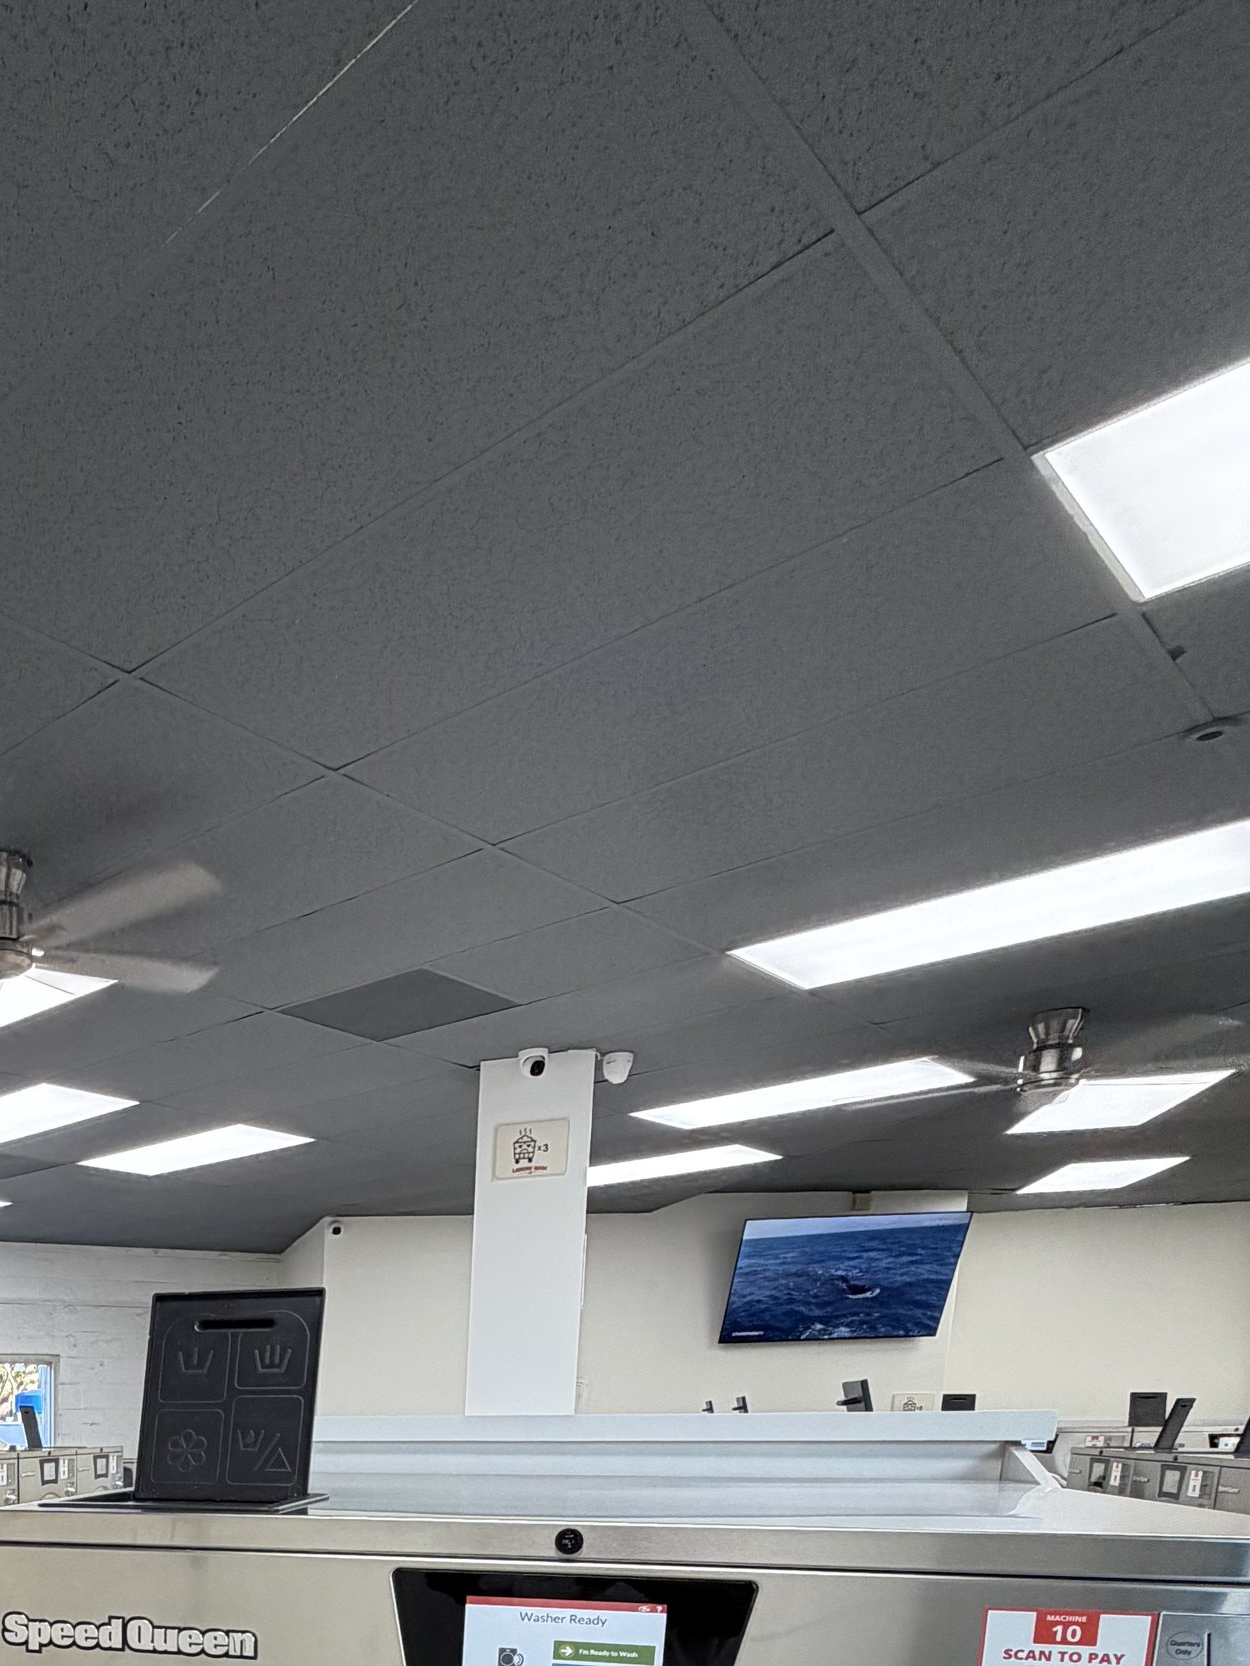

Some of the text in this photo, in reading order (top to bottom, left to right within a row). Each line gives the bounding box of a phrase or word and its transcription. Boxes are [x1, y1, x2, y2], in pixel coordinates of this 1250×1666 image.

[519, 1612, 608, 1628] Washer Ready
[1046, 1614, 1087, 1623] MACHINE
[1, 1611, 125, 1653] Speed
[125, 1615, 258, 1660] Queen
[1052, 1625, 1082, 1643] 10
[579, 1648, 589, 1656] I'm
[590, 1649, 609, 1657] Ready
[1002, 1648, 1126, 1665] SCAN TO PAY
